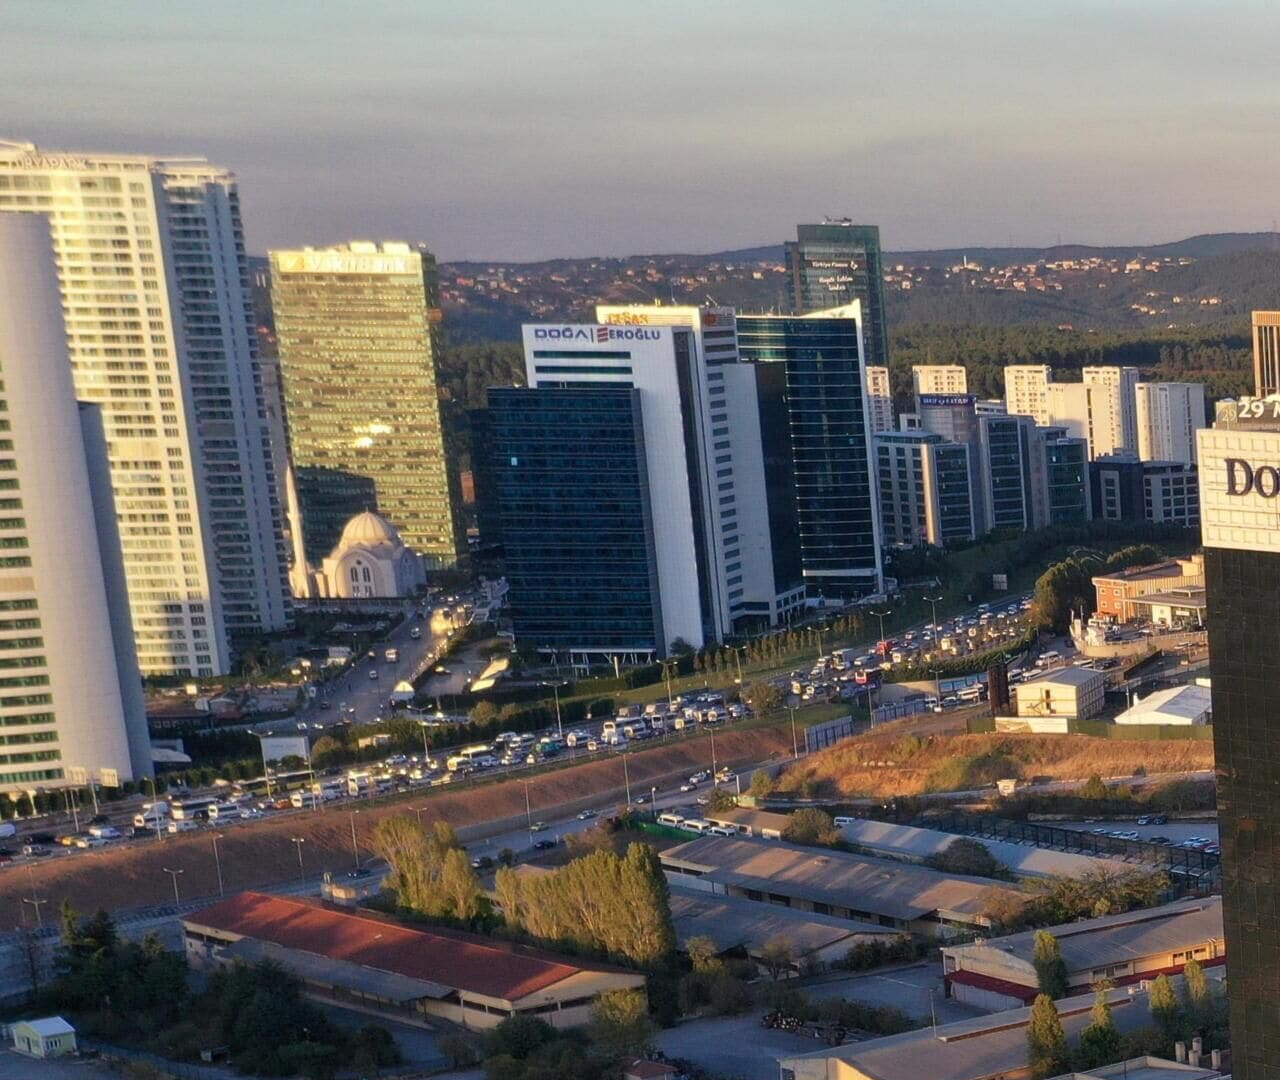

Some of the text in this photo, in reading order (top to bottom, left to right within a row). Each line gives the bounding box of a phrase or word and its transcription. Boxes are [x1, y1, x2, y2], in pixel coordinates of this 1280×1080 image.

[534, 327, 588, 340] DOĞA
[609, 328, 661, 341] EROĞLU
[1238, 400, 1265, 419] 29
